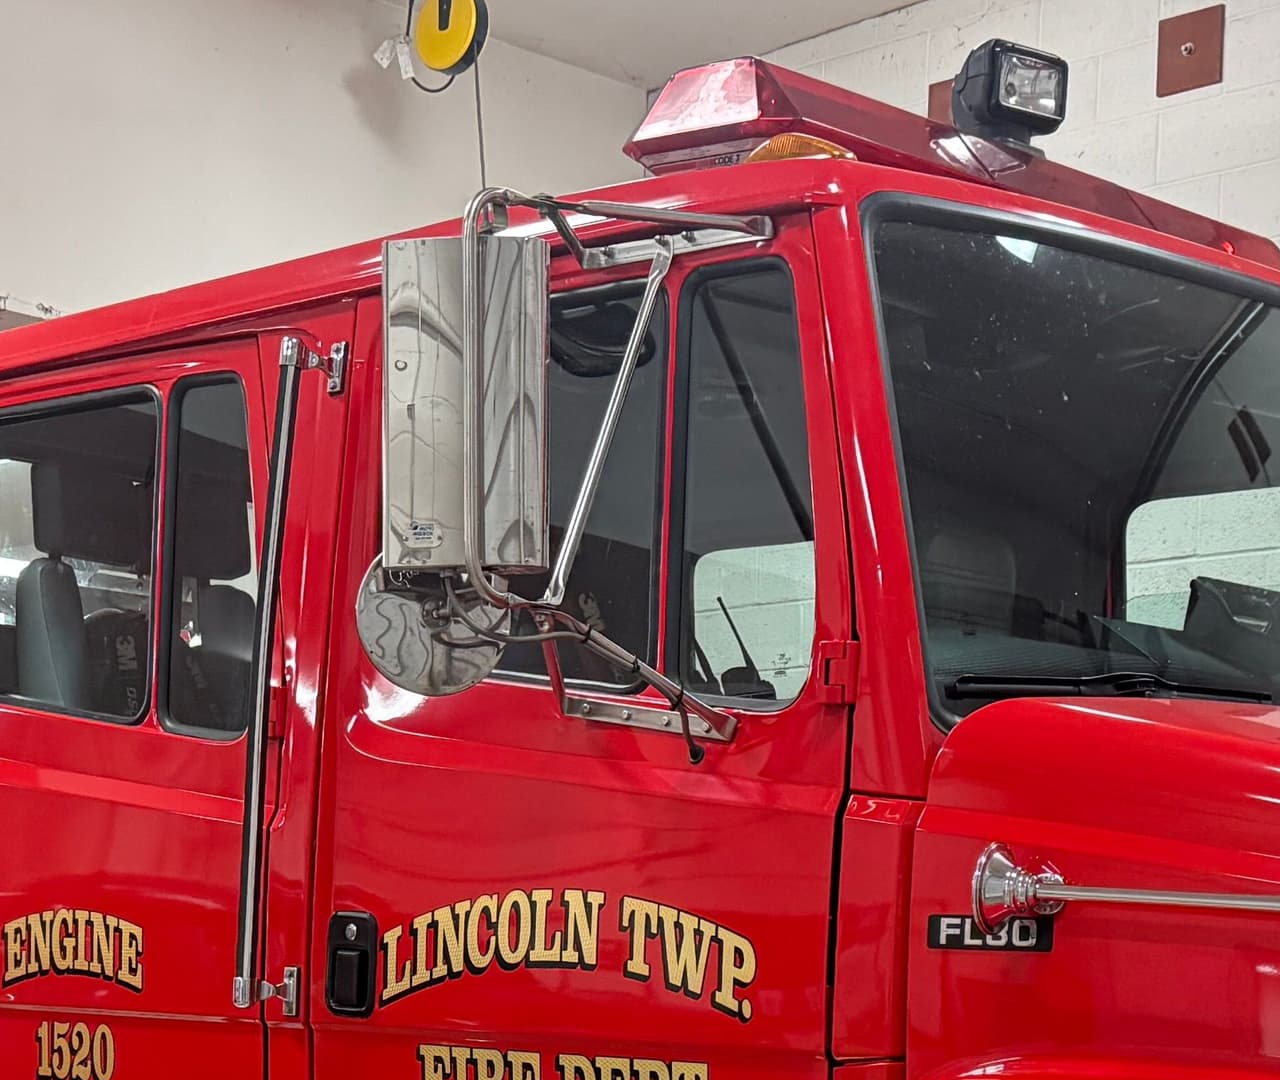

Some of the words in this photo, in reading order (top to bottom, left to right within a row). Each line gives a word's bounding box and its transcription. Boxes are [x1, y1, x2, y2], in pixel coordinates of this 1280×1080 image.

[2, 907, 144, 992] ENGINE
[380, 888, 606, 1007] LINCOLN
[620, 895, 758, 1023] TWP.
